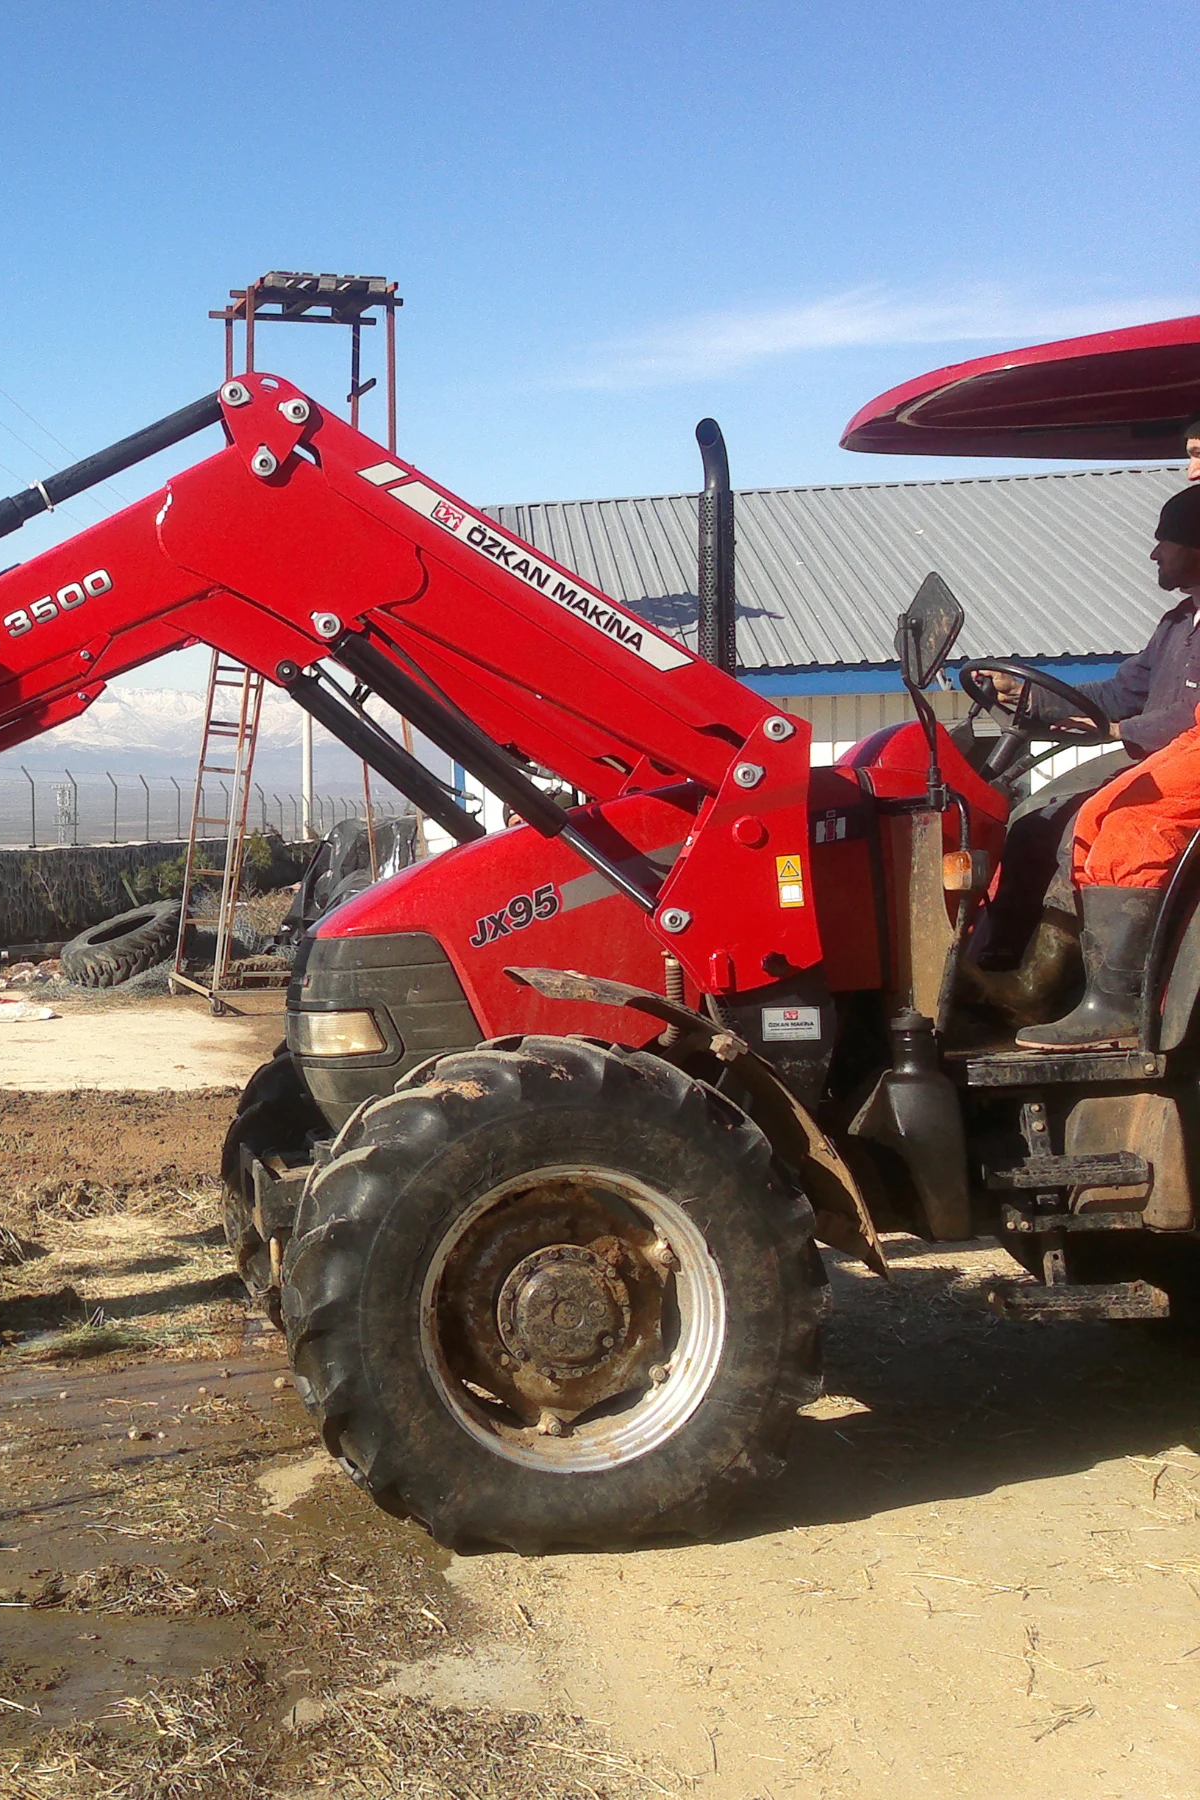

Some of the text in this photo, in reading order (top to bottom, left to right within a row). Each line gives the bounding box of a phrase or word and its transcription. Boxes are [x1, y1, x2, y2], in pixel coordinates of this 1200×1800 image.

[3, 568, 113, 638] 3500
[466, 524, 643, 652] ÖZKAN MAKİNA
[469, 882, 559, 948] JX95
